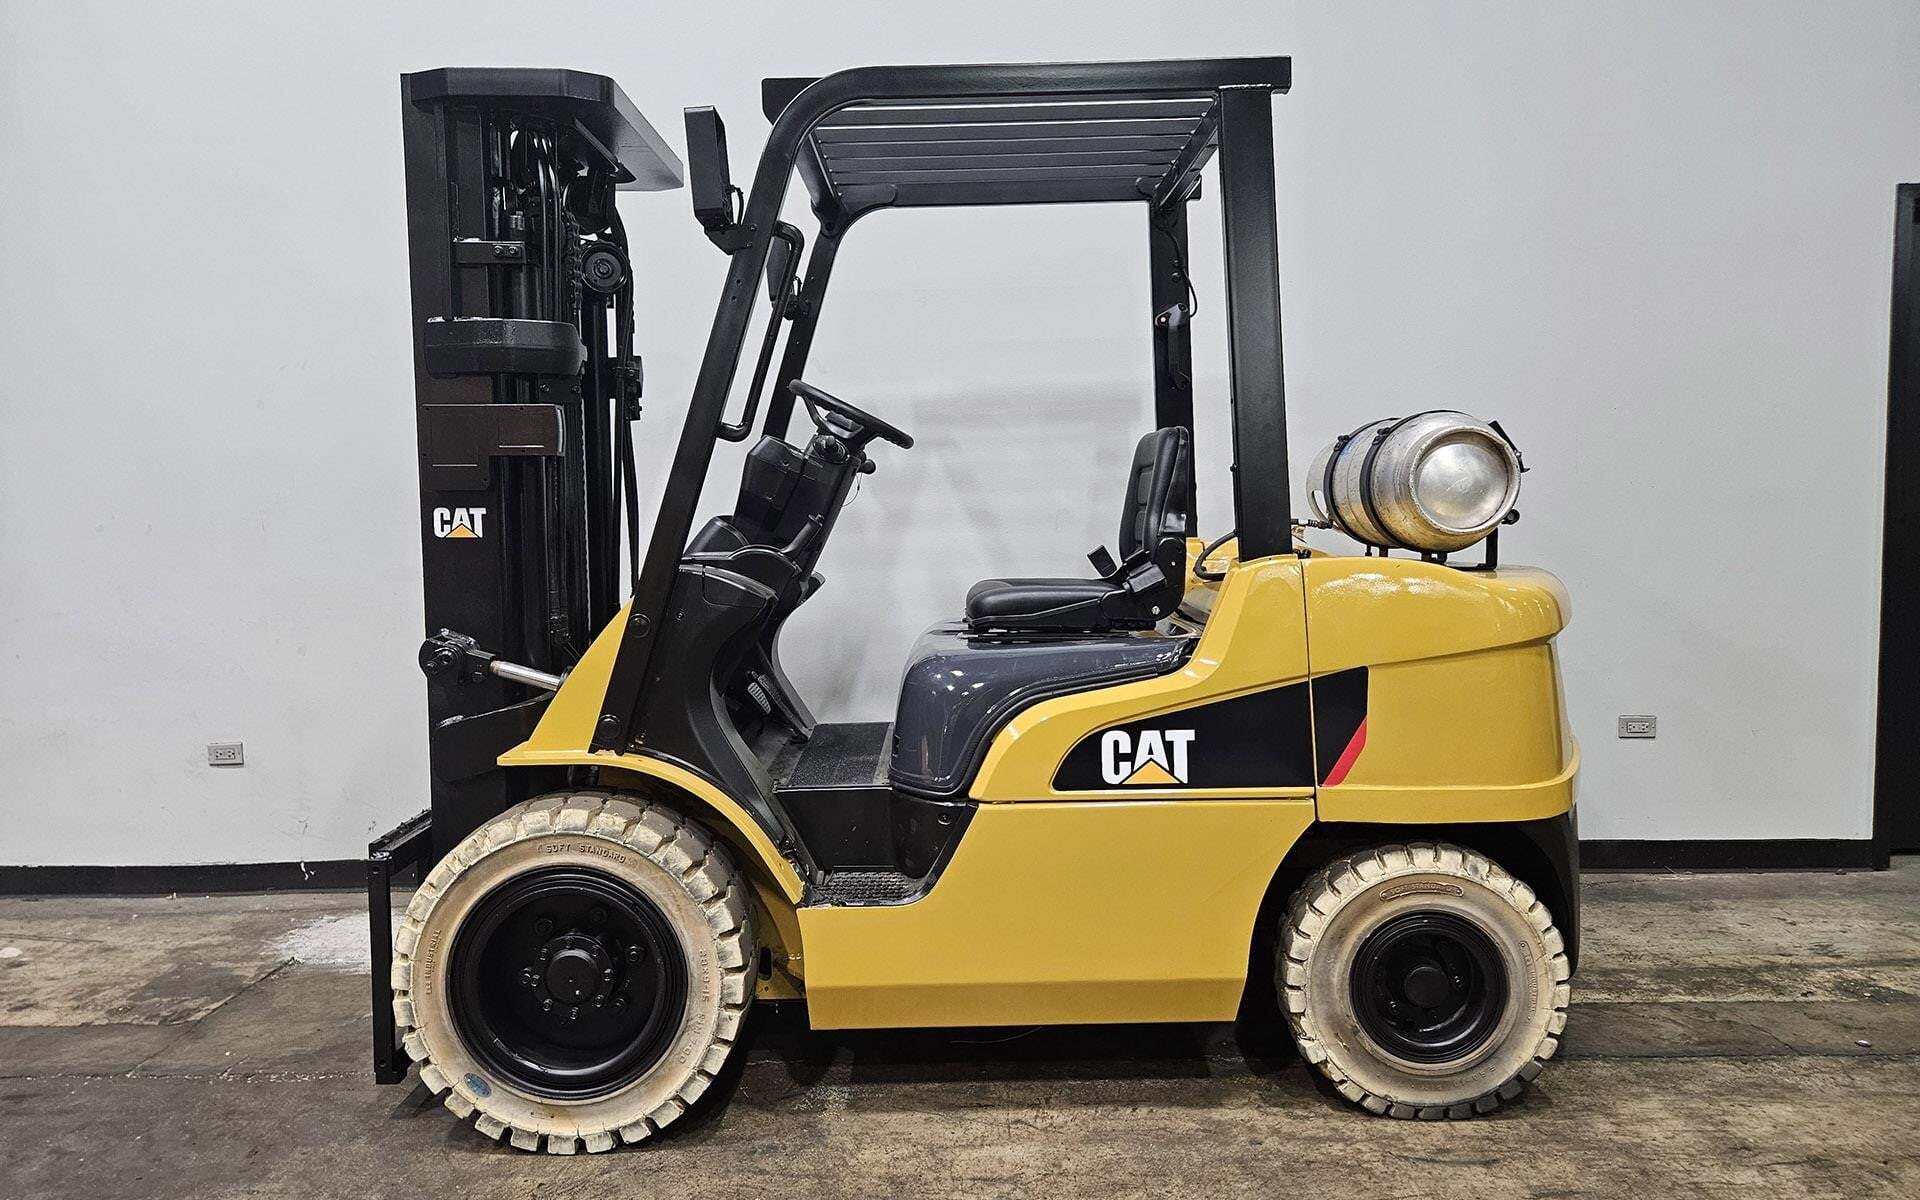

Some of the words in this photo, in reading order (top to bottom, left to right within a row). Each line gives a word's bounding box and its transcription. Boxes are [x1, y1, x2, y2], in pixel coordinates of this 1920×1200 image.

[433, 507, 487, 538] CAT
[1101, 729, 1196, 785] CAT
[546, 844, 571, 854] SOFT
[579, 845, 627, 864] STANDARD
